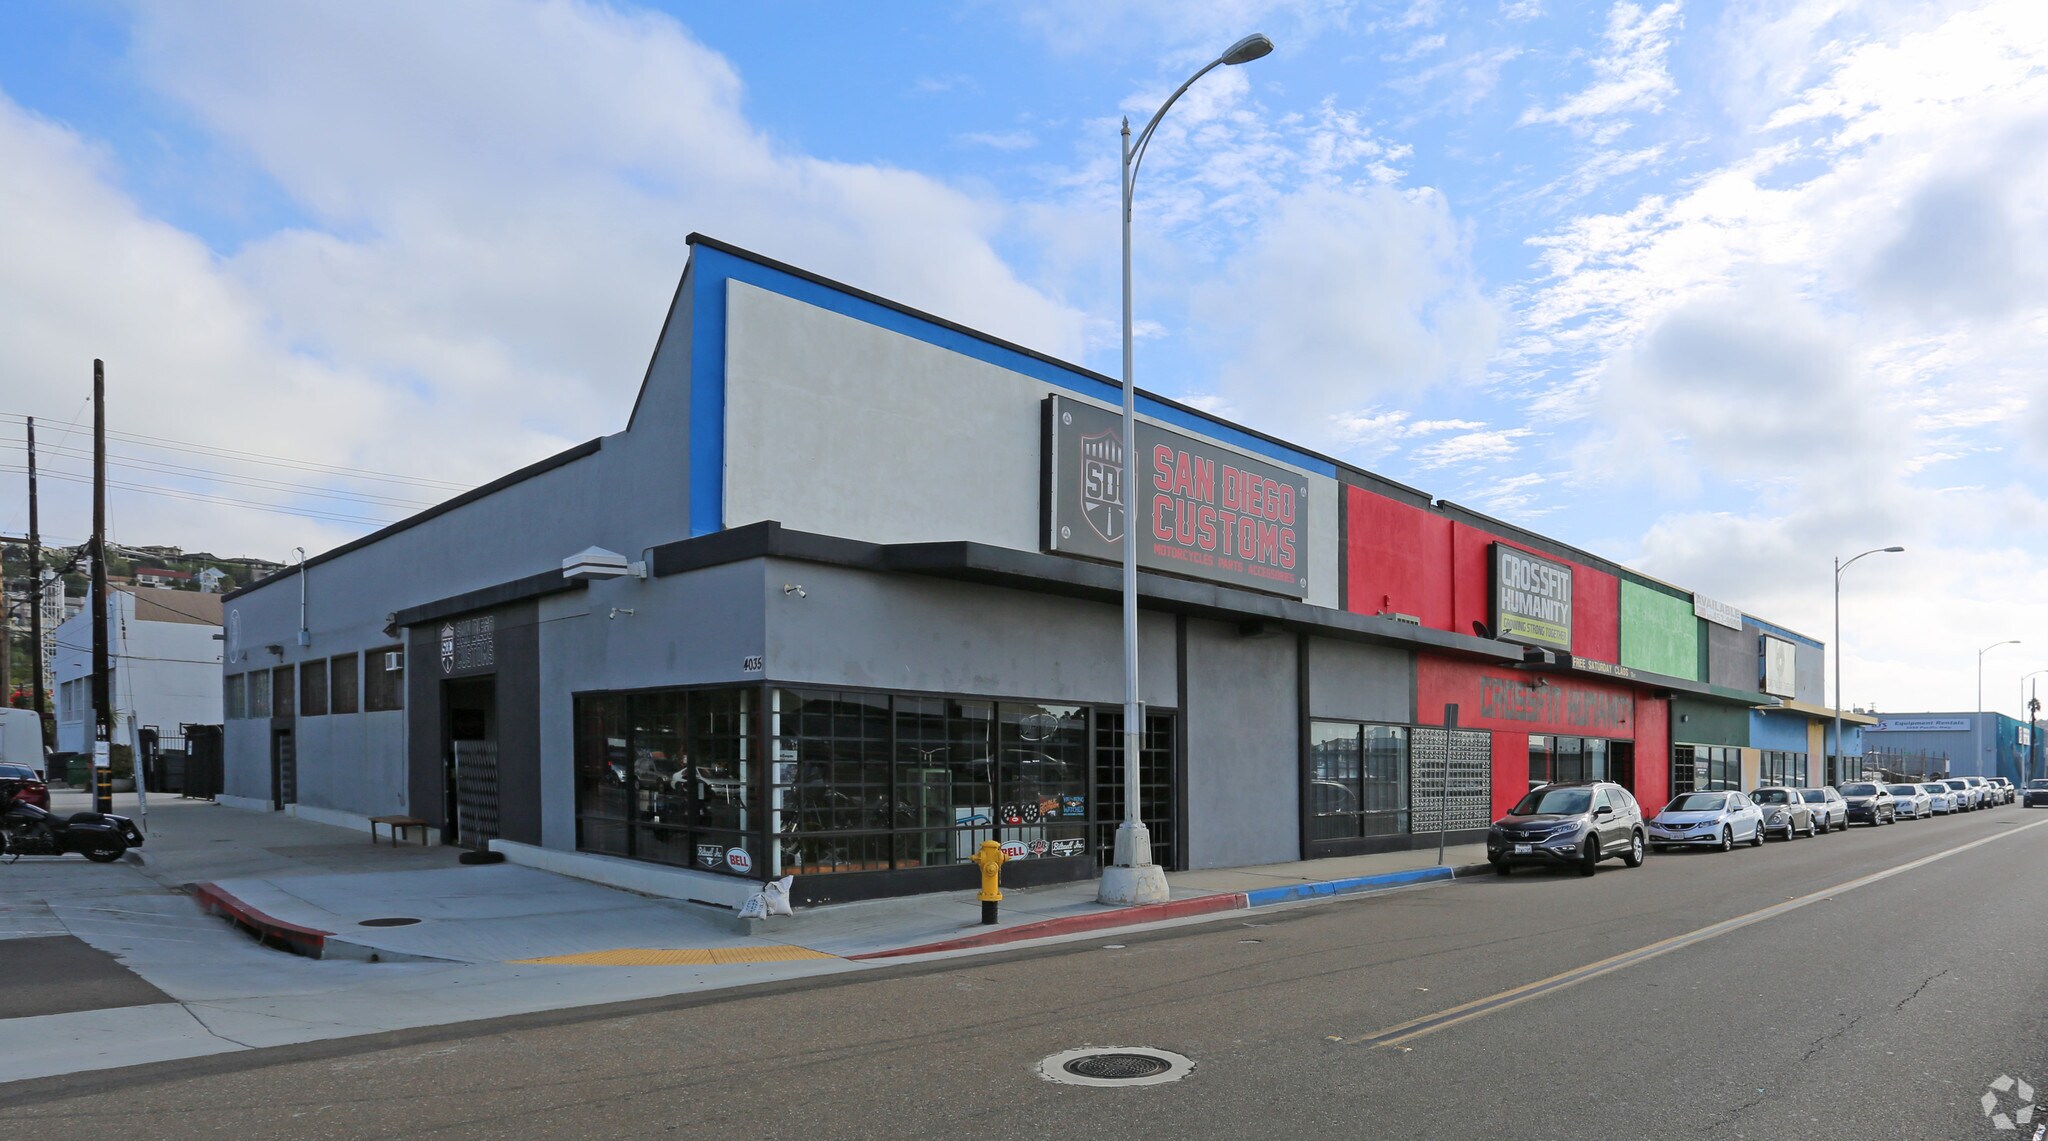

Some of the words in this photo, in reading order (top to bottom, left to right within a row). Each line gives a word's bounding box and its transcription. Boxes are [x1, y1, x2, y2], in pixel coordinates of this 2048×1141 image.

[1087, 461, 1124, 504] SD
[1153, 444, 1215, 505] SAN
[1222, 465, 1296, 526] DIEGO
[1152, 493, 1296, 569] CUSTOMS
[1154, 544, 1214, 567] MOTORCYCLES
[1218, 558, 1243, 573] PARTS
[1248, 565, 1296, 584] ACCESSORIES
[1502, 553, 1568, 601] CROSSFIT
[1502, 587, 1568, 624] HUMANITY
[1696, 594, 1741, 618] AVAILABLE
[1504, 617, 1526, 633] GROWING
[1527, 623, 1545, 637] STRONG
[1546, 627, 1567, 641] TOGETHER
[457, 641, 495, 668] CUSTOMS
[744, 656, 762, 671] 4035
[1572, 657, 1586, 669] FREE
[1588, 660, 1612, 674] SATURDAY
[1614, 665, 1629, 677] CLASS
[1480, 676, 1562, 724] CROSSFIT
[1567, 688, 1633, 730] HUMANITY
[730, 854, 749, 867] BELL
